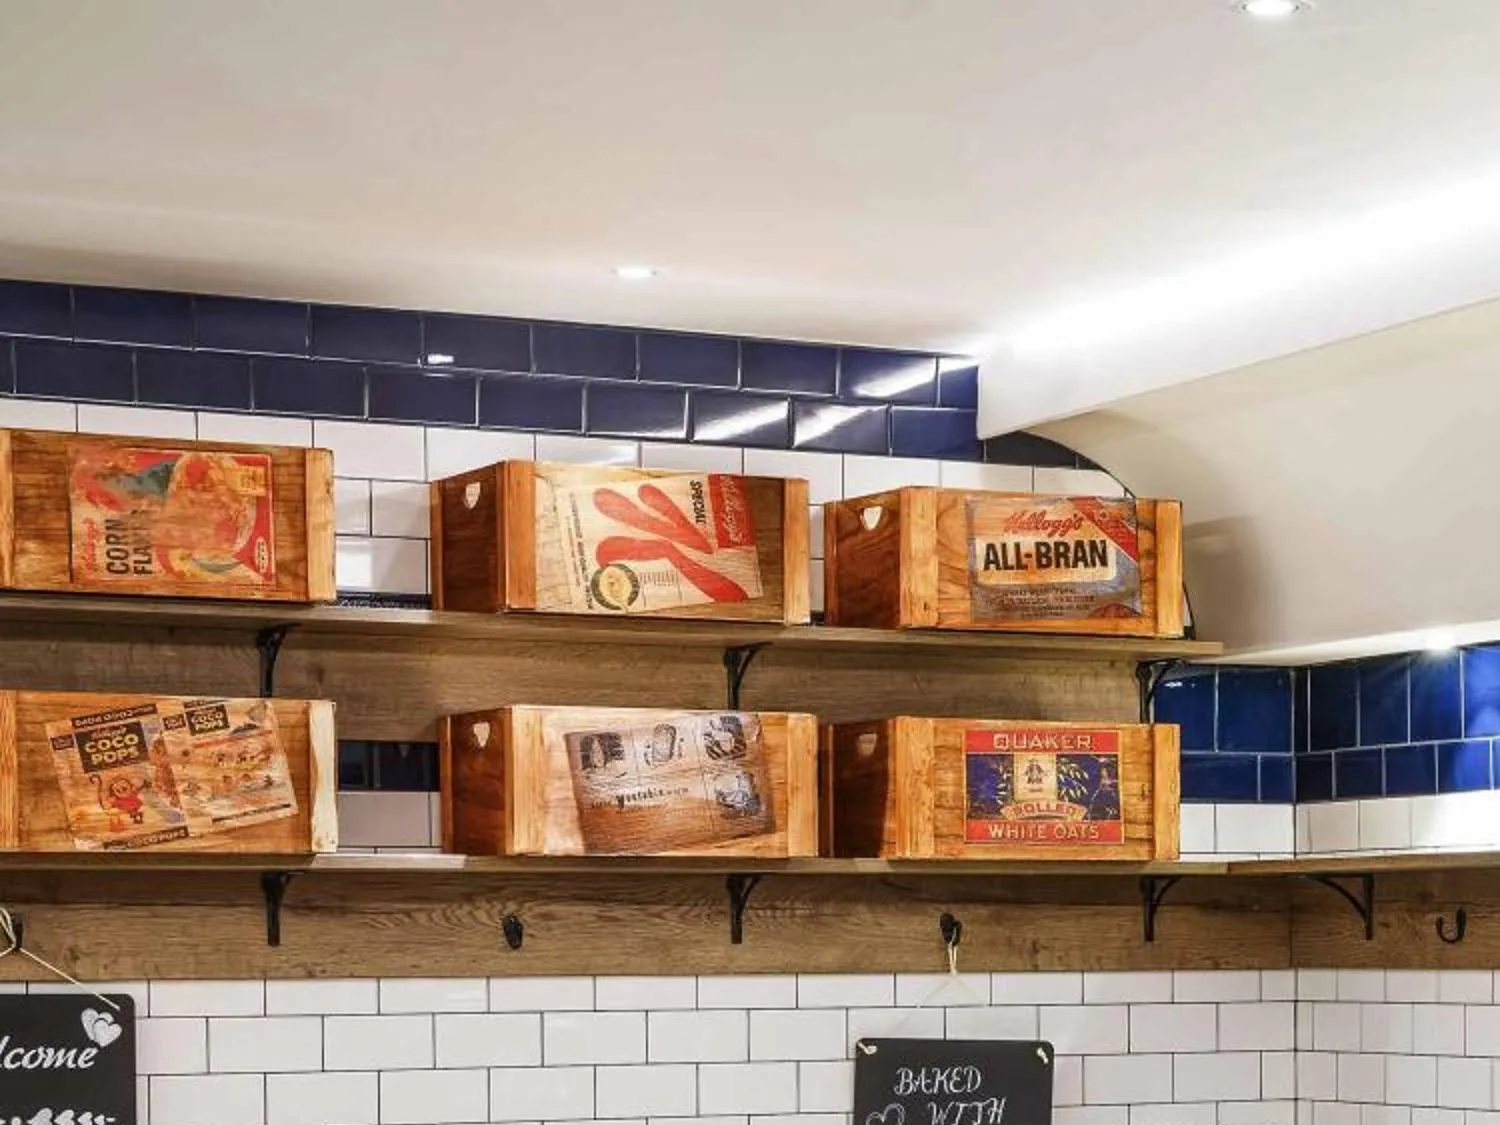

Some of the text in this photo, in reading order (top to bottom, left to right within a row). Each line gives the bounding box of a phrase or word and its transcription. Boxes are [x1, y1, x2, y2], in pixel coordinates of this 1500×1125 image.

[689, 480, 707, 524] SPECIAL
[1003, 508, 1084, 538] Kellogg's
[105, 519, 130, 575] CORN
[131, 509, 154, 575] FLA
[983, 539, 1109, 571] ALL-BRAN
[84, 733, 139, 753] COCO
[91, 745, 140, 765] POPS
[993, 732, 1092, 750] QUAKER
[988, 823, 1099, 839] WHITE OATS
[894, 1065, 982, 1095] BAKED
